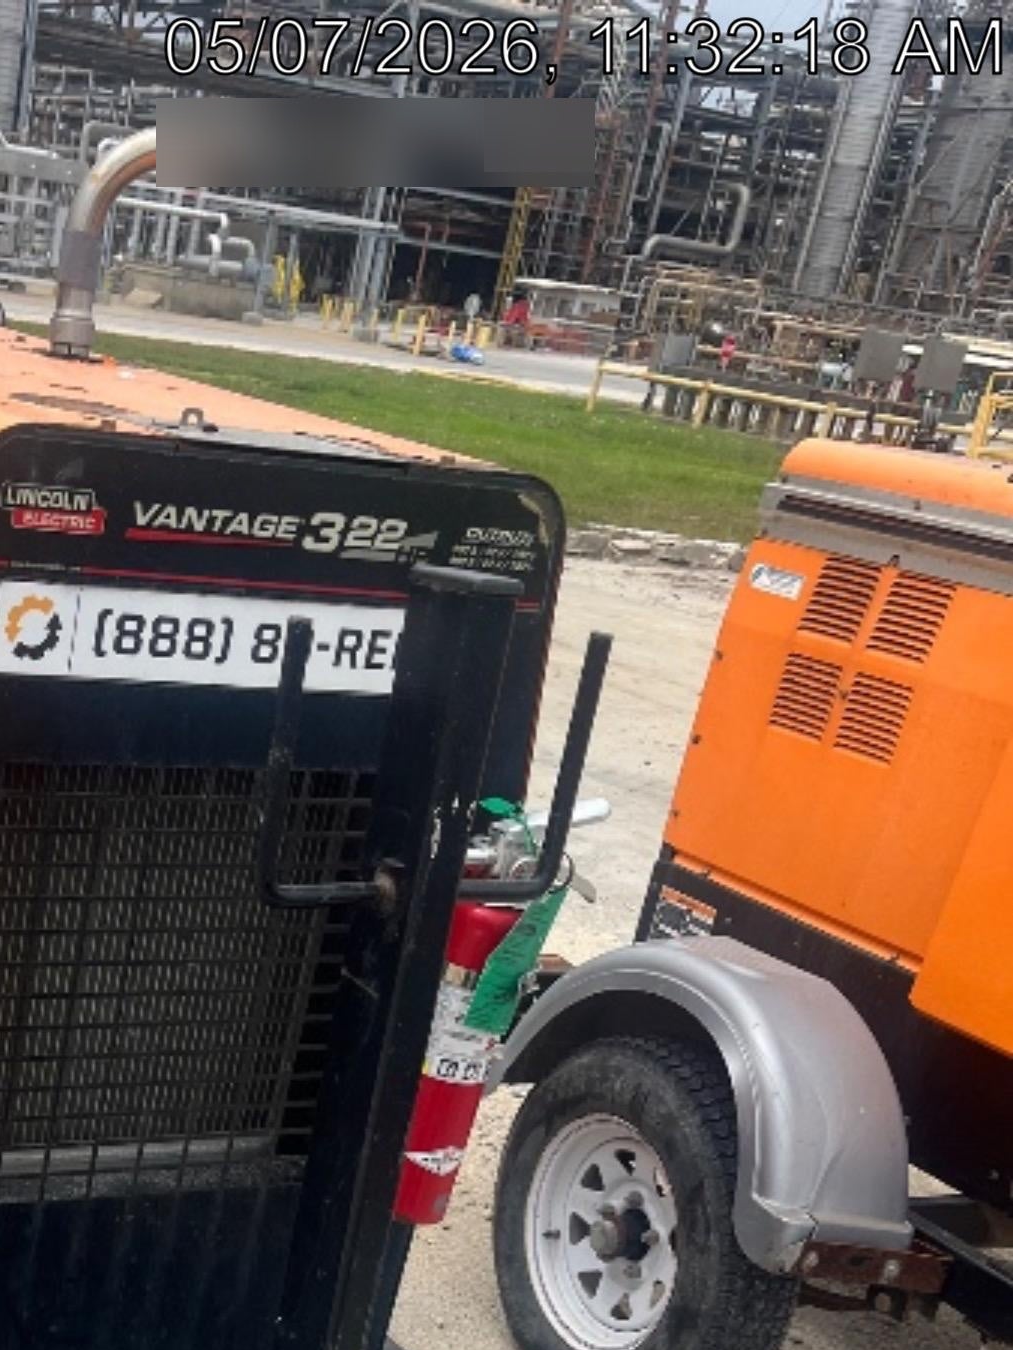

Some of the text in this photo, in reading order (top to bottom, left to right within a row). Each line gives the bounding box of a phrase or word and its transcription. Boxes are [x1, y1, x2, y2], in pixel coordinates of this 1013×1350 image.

[5, 485, 90, 511] LINCOLN
[21, 510, 98, 530] ELECTRIC
[133, 499, 409, 553] VANTAGE 322
[92, 608, 235, 664] (888)
